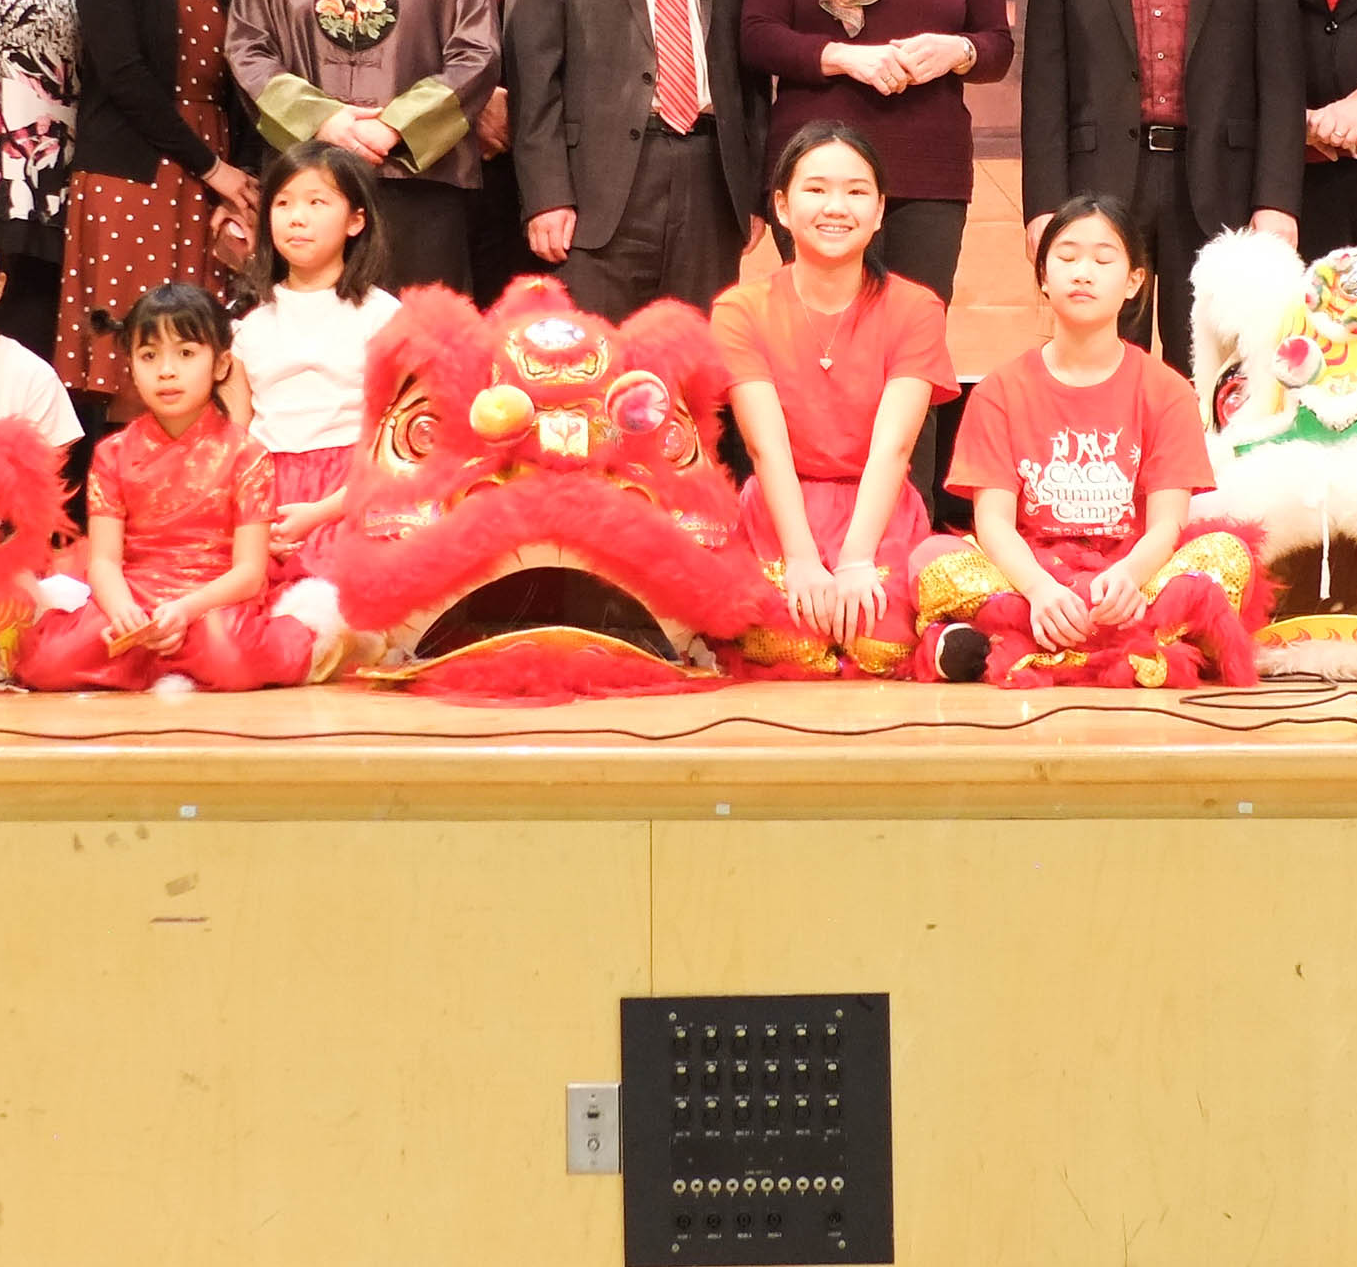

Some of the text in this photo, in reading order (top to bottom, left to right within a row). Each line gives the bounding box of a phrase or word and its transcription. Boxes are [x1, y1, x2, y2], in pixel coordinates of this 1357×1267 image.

[1049, 465, 1123, 484] CACA
[1042, 482, 1132, 502] Summer
[1056, 501, 1121, 522] Camp
